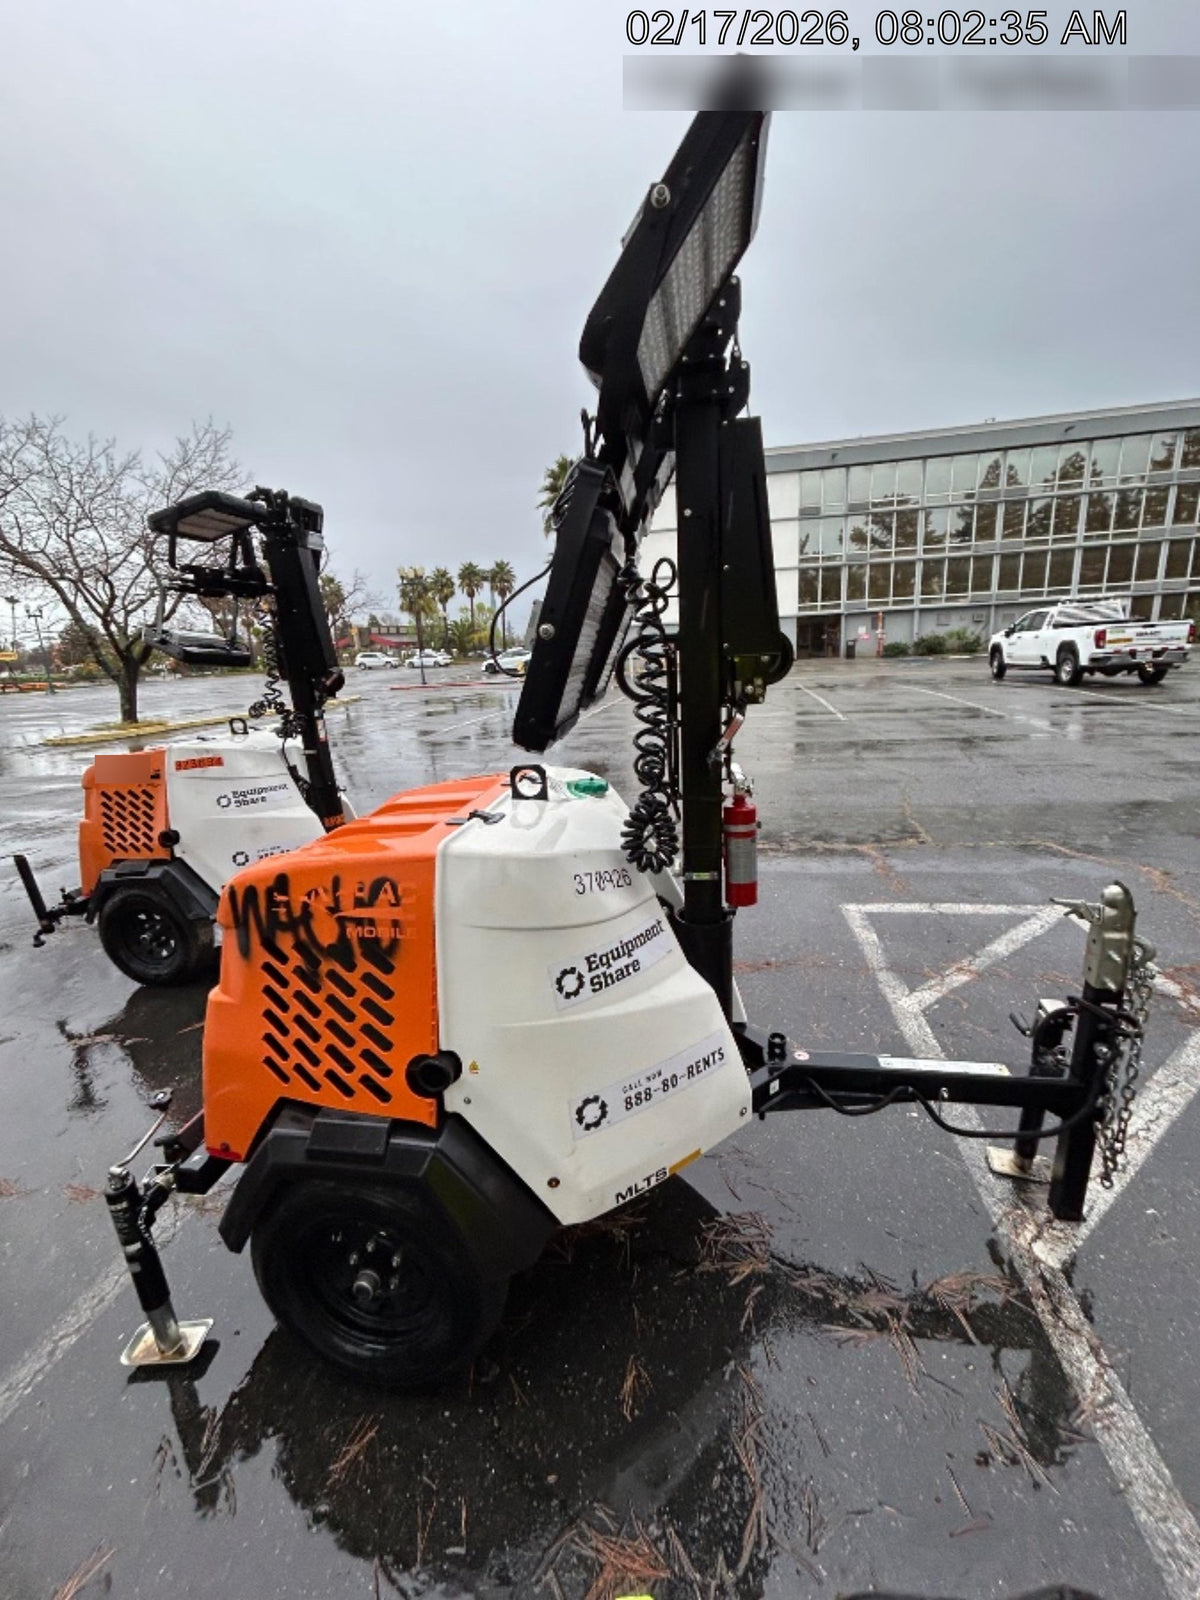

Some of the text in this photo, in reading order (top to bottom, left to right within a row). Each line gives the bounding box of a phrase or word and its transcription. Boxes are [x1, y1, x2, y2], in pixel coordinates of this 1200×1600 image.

[584, 919, 665, 973] Equipment
[589, 958, 641, 994] Share
[624, 1047, 725, 1112] 888-80-RENTS
